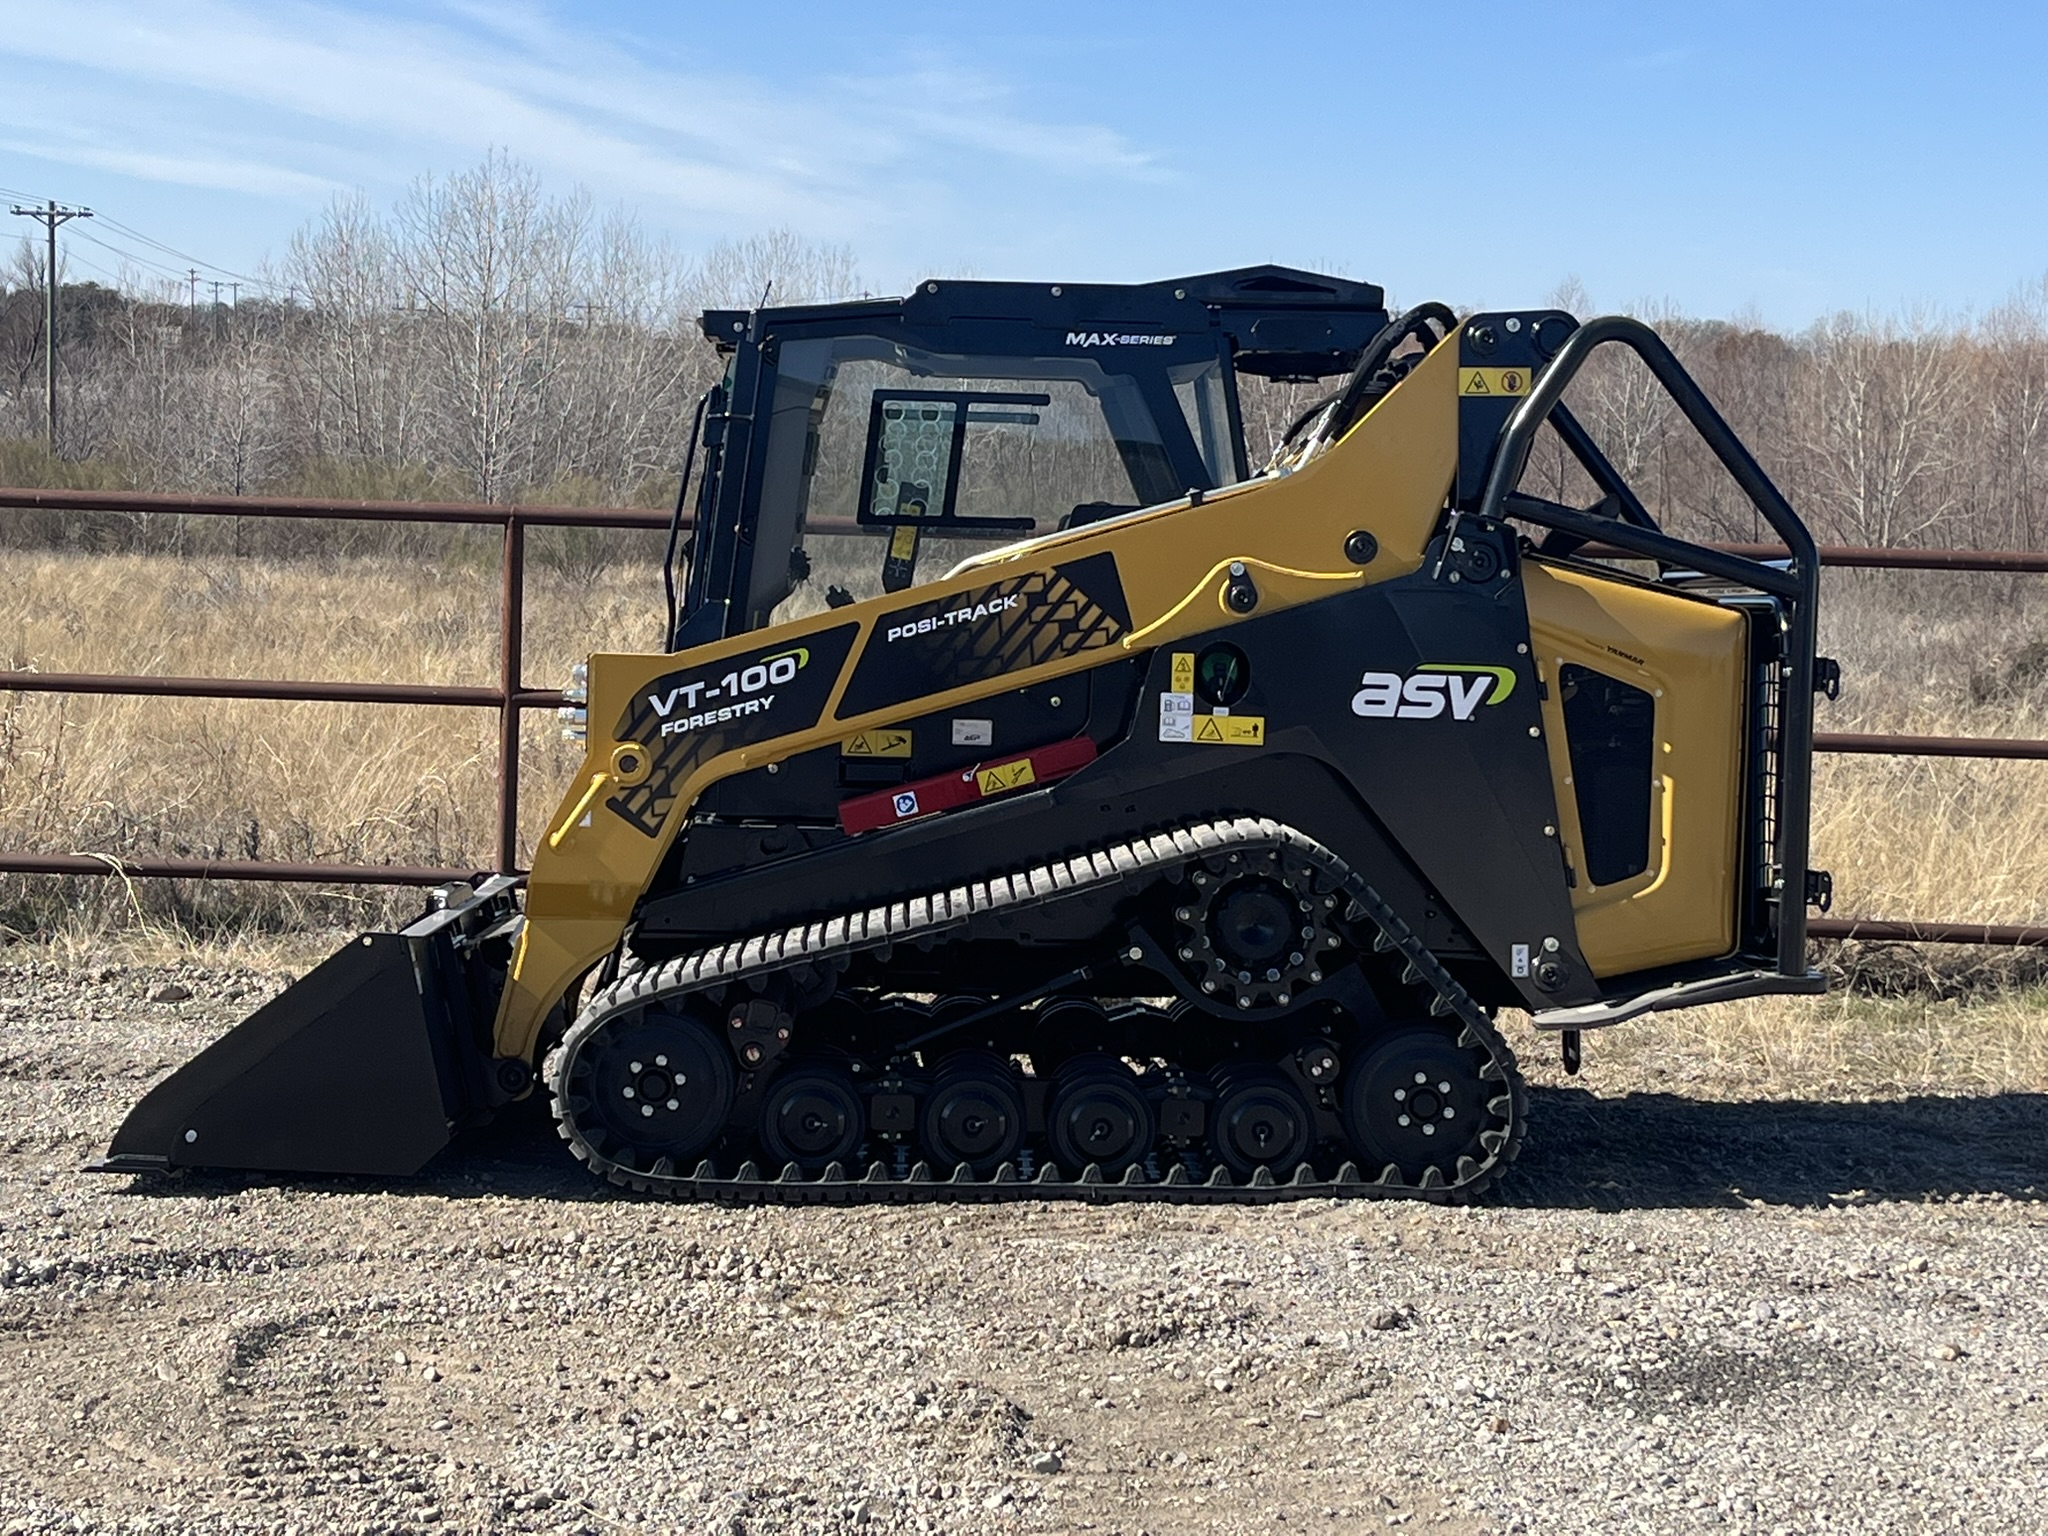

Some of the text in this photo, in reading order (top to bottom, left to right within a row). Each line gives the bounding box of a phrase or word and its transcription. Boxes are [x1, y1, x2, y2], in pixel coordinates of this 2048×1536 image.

[1065, 332, 1176, 348] MAX-SERIES
[887, 594, 1018, 642] POSI-TRACK
[648, 657, 796, 717] VT-100
[661, 695, 775, 737] FORESTRY
